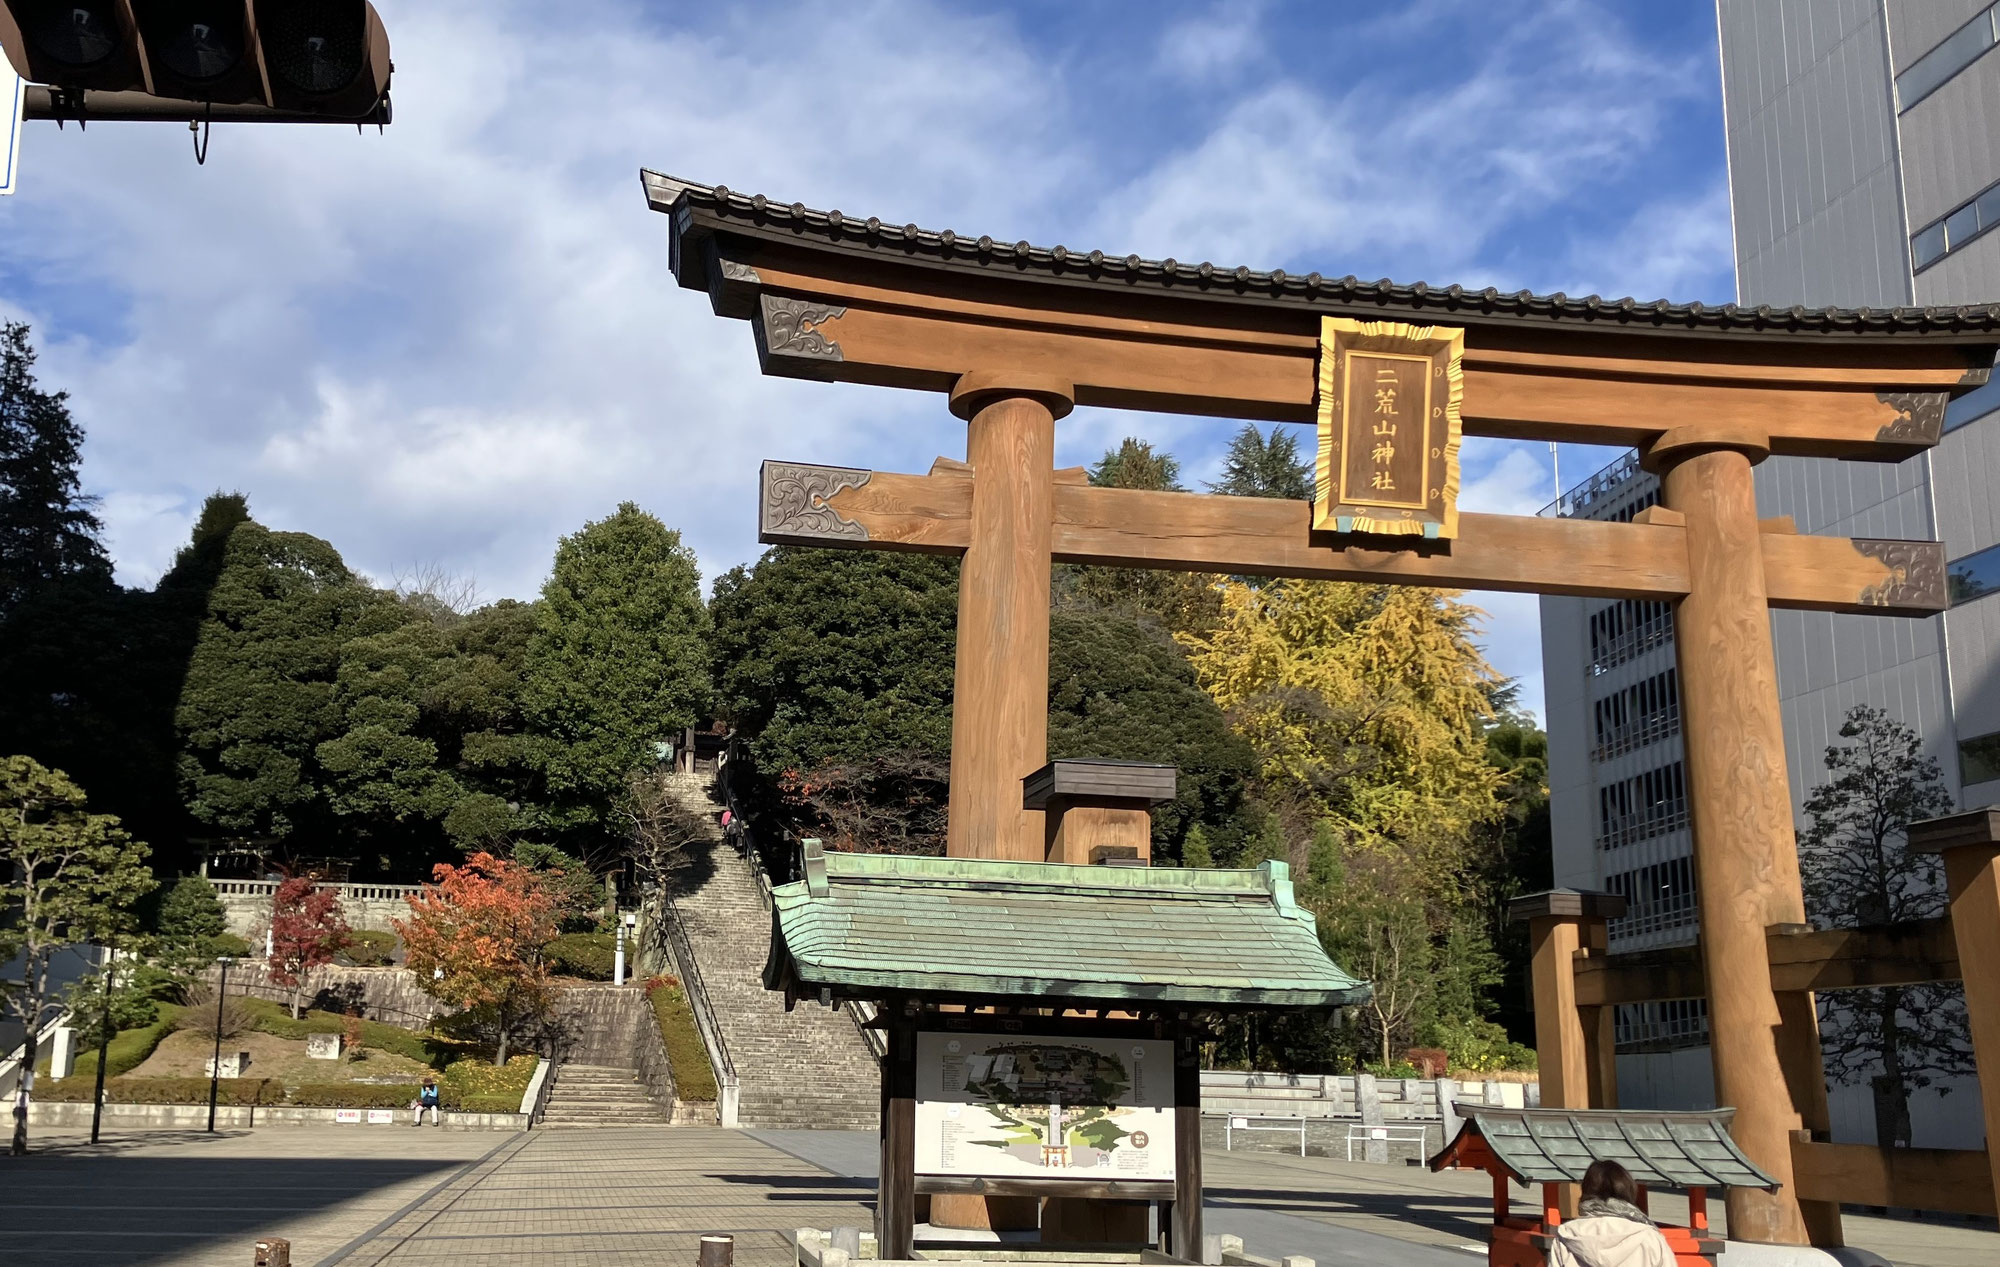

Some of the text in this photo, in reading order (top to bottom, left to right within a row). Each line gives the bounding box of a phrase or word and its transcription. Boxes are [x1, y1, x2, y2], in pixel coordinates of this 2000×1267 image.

[1370, 368, 1399, 491] 二荒山神社
